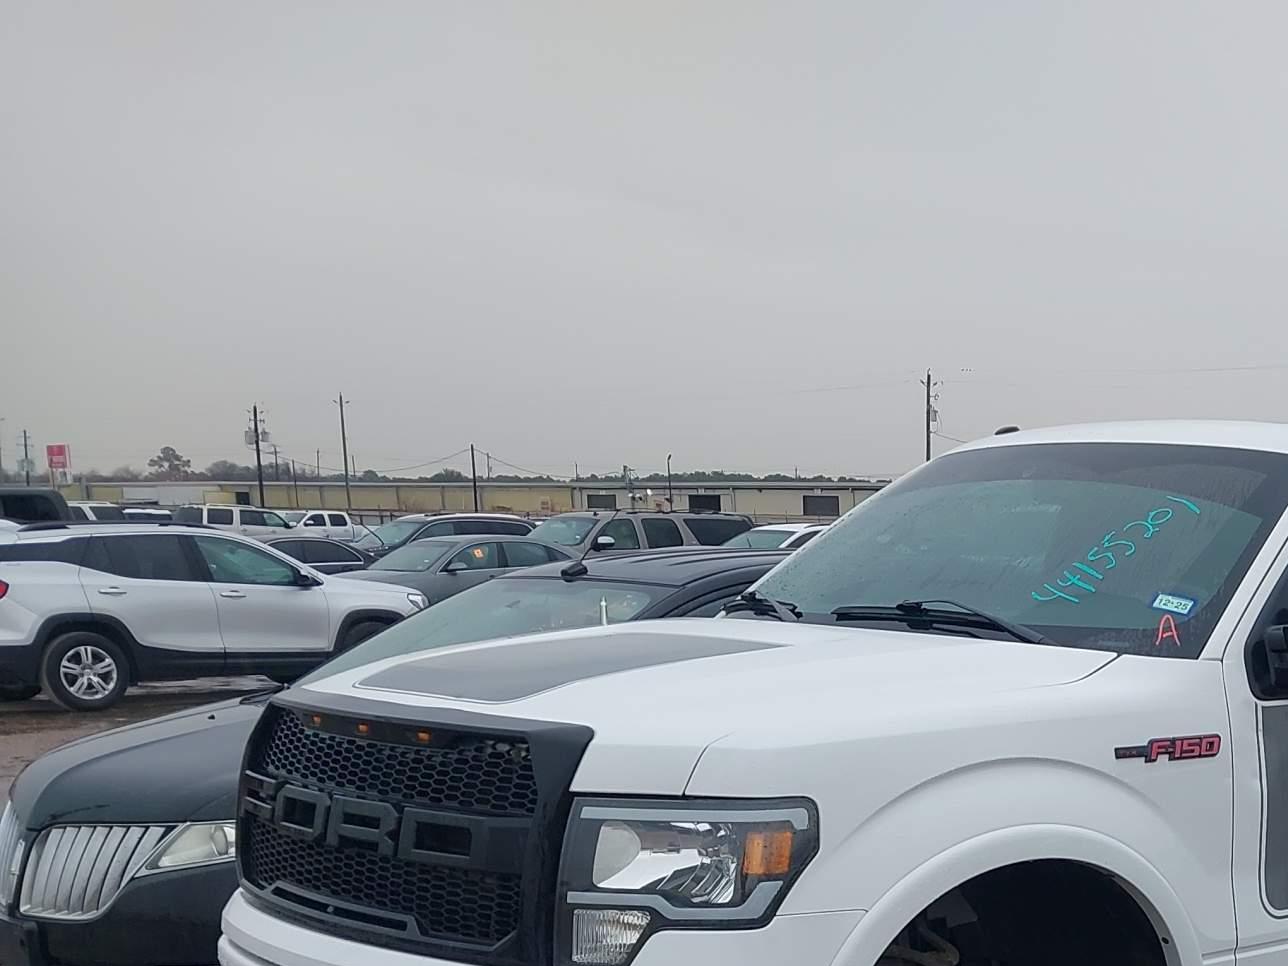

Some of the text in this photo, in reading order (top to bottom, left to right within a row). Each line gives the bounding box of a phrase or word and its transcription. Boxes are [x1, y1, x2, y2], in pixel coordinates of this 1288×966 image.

[1031, 494, 1201, 605] 44155201
[1155, 614, 1181, 647] A
[1150, 735, 1221, 761] F-150
